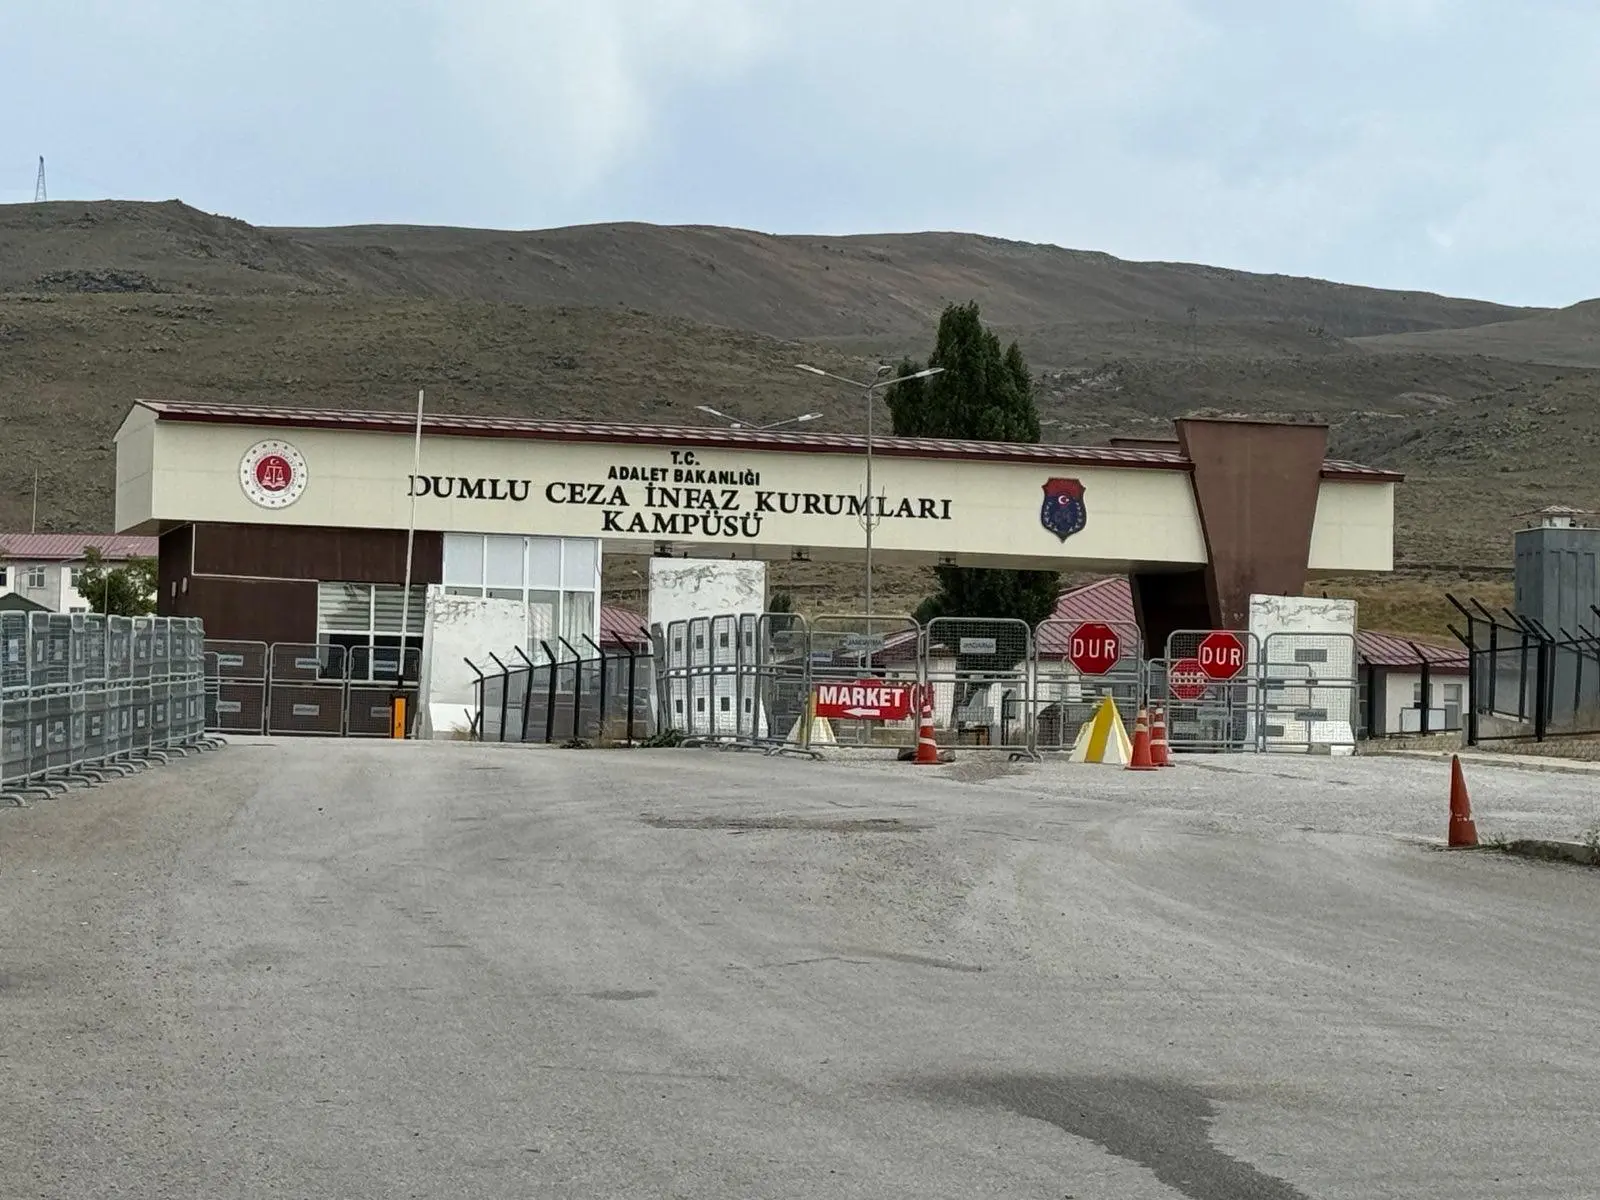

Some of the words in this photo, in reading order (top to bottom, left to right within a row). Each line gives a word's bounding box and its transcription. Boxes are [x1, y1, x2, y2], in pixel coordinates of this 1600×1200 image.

[671, 451, 700, 465] T.C.
[608, 466, 669, 482] ADALET
[673, 469, 761, 486] BAKANLIĞI
[407, 475, 531, 501] DUMLU
[545, 482, 630, 507] CEZA
[644, 482, 741, 511] İNFAZ
[755, 491, 953, 520] KURUMLARI
[601, 510, 763, 538] KAMPÜSÜ
[1073, 638, 1116, 660] DUR
[1202, 646, 1241, 667] DUR
[819, 685, 905, 708] MARKET
